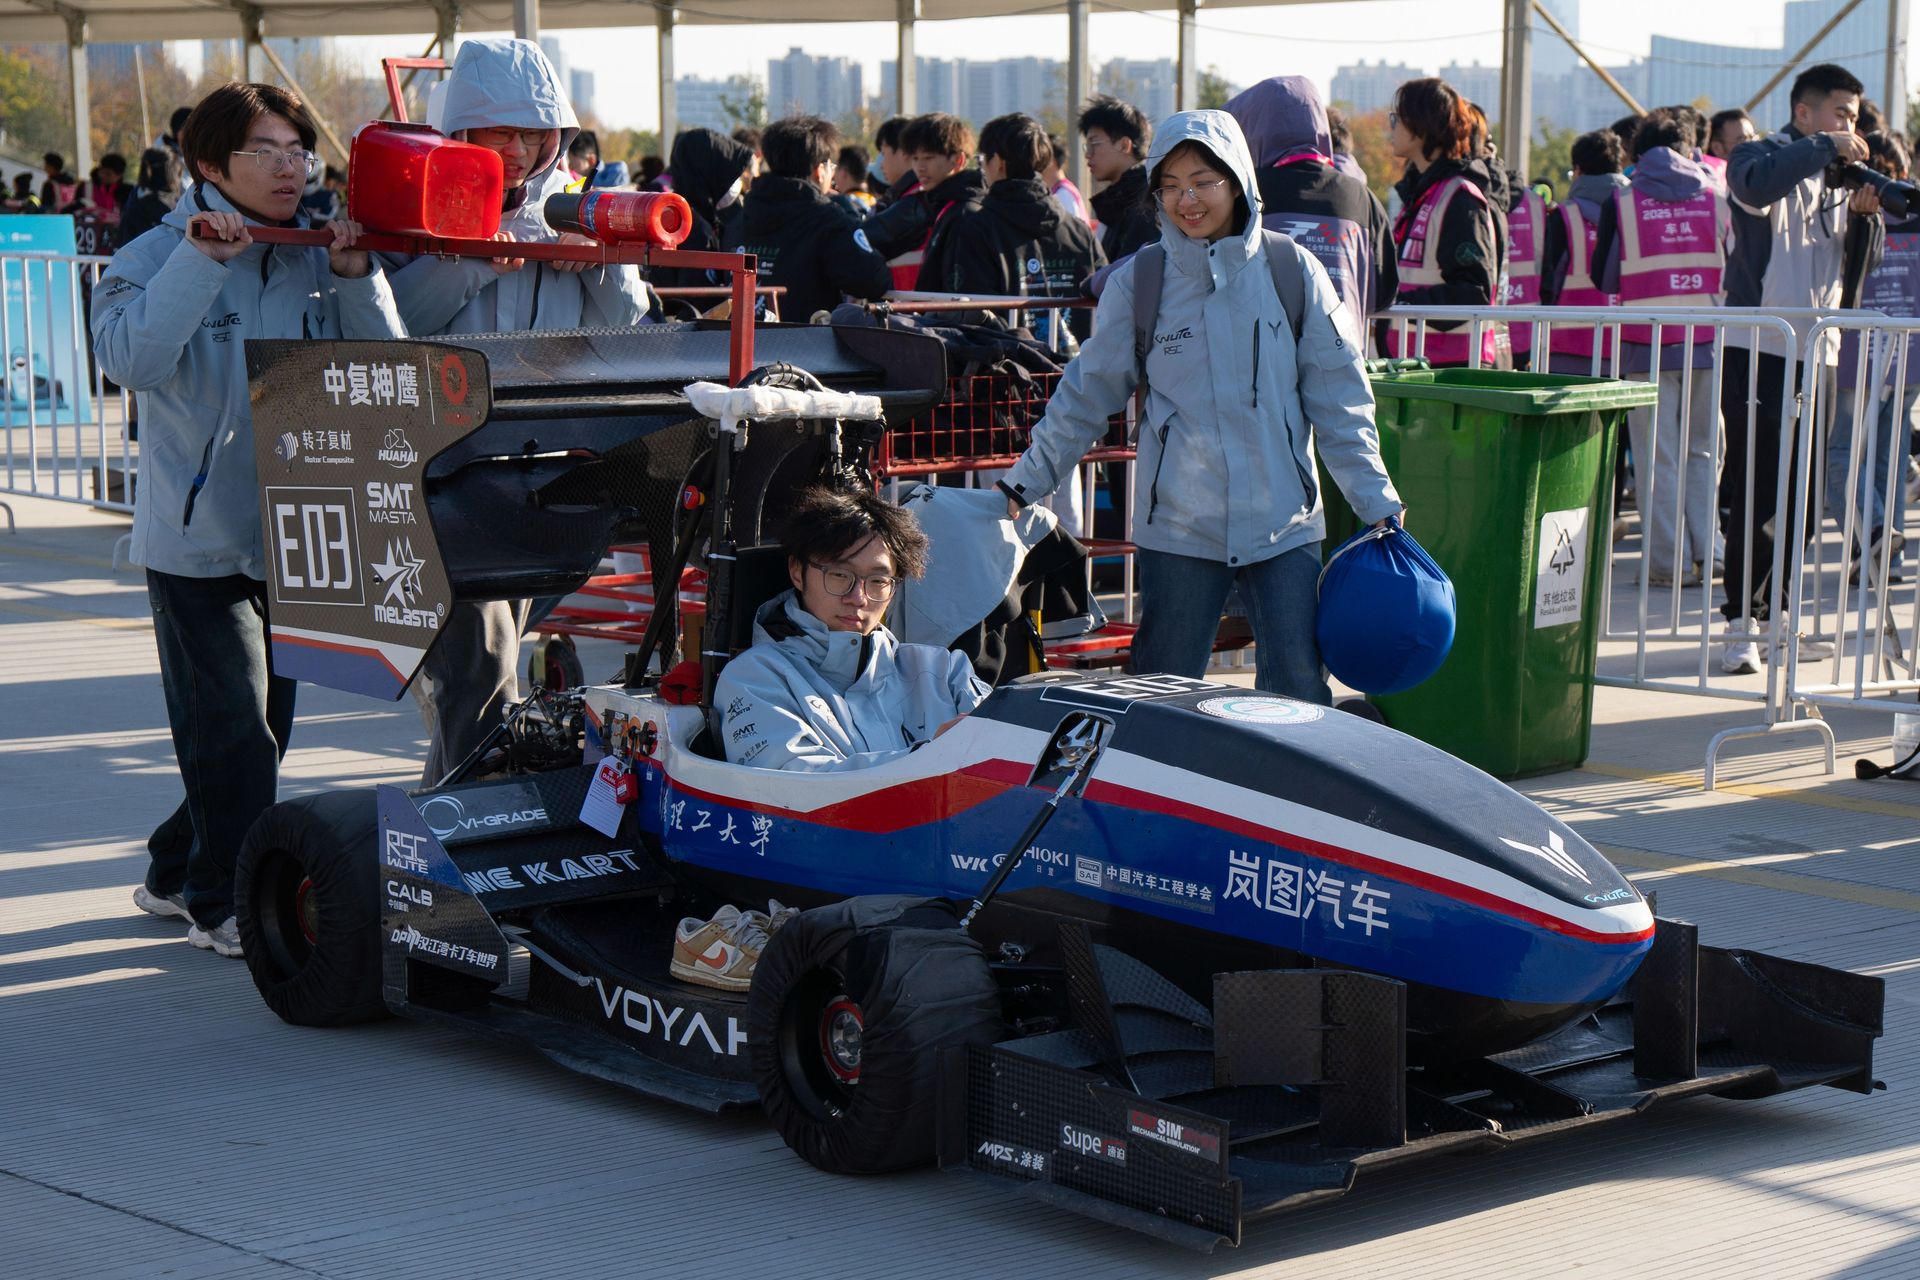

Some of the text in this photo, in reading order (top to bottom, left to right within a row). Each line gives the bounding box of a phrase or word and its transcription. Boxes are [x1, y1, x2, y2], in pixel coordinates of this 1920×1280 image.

[1670, 274, 1703, 290] E29
[324, 362, 420, 407] 中复神鹰
[303, 430, 352, 452] 转子复材
[323, 456, 355, 465] Composite
[378, 450, 418, 463] HUAHAI
[367, 482, 414, 510] SMT
[369, 510, 417, 525] MASTA
[276, 504, 352, 589] E03
[1544, 587, 1576, 606] 其他垃圾
[458, 808, 547, 829] VI-GRADE
[386, 829, 427, 860] RSC
[387, 856, 428, 874] WUTE
[522, 849, 640, 885] KART
[1079, 870, 1099, 882] SAE
[1106, 866, 1213, 901] 中国汽车工程学会
[387, 880, 433, 906] CALB
[1223, 850, 1391, 936] 岚图汽车
[1132, 1125, 1166, 1144] MECHANICAL
